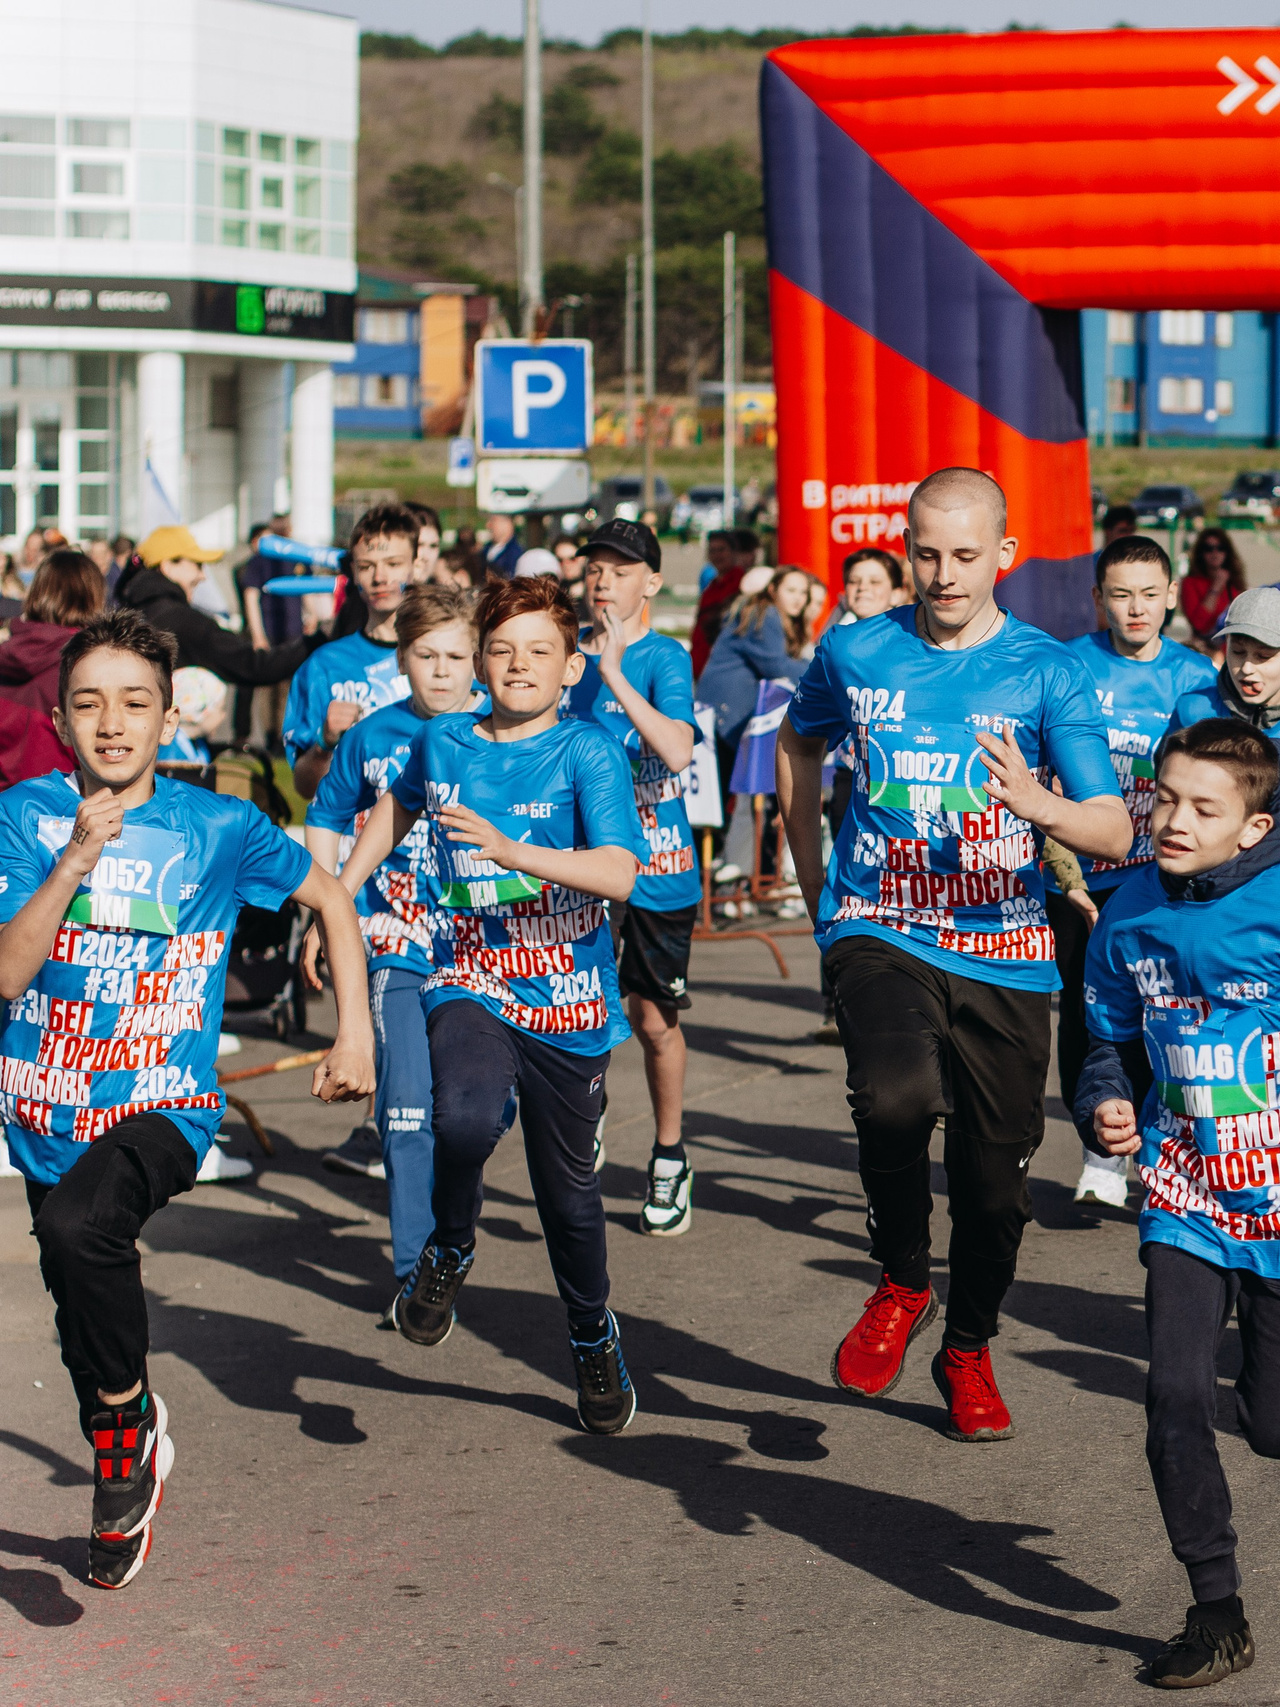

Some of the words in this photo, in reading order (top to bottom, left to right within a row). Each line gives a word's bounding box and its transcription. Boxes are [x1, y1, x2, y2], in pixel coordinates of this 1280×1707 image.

[511, 360, 567, 438] P
[802, 480, 826, 509] В
[831, 511, 908, 544] СТРА
[846, 686, 906, 724] 2024
[1107, 727, 1151, 756] 0030
[892, 750, 960, 782] 10027
[530, 803, 553, 818] БЕГ
[550, 965, 602, 1006] 2024
[36, 1029, 172, 1072] #ГОРДОСТЬ
[1165, 1043, 1235, 1081] 10046
[130, 1064, 198, 1101] 2024
[388, 1120, 421, 1132] TODAY
[401, 1107, 425, 1120] TIME
